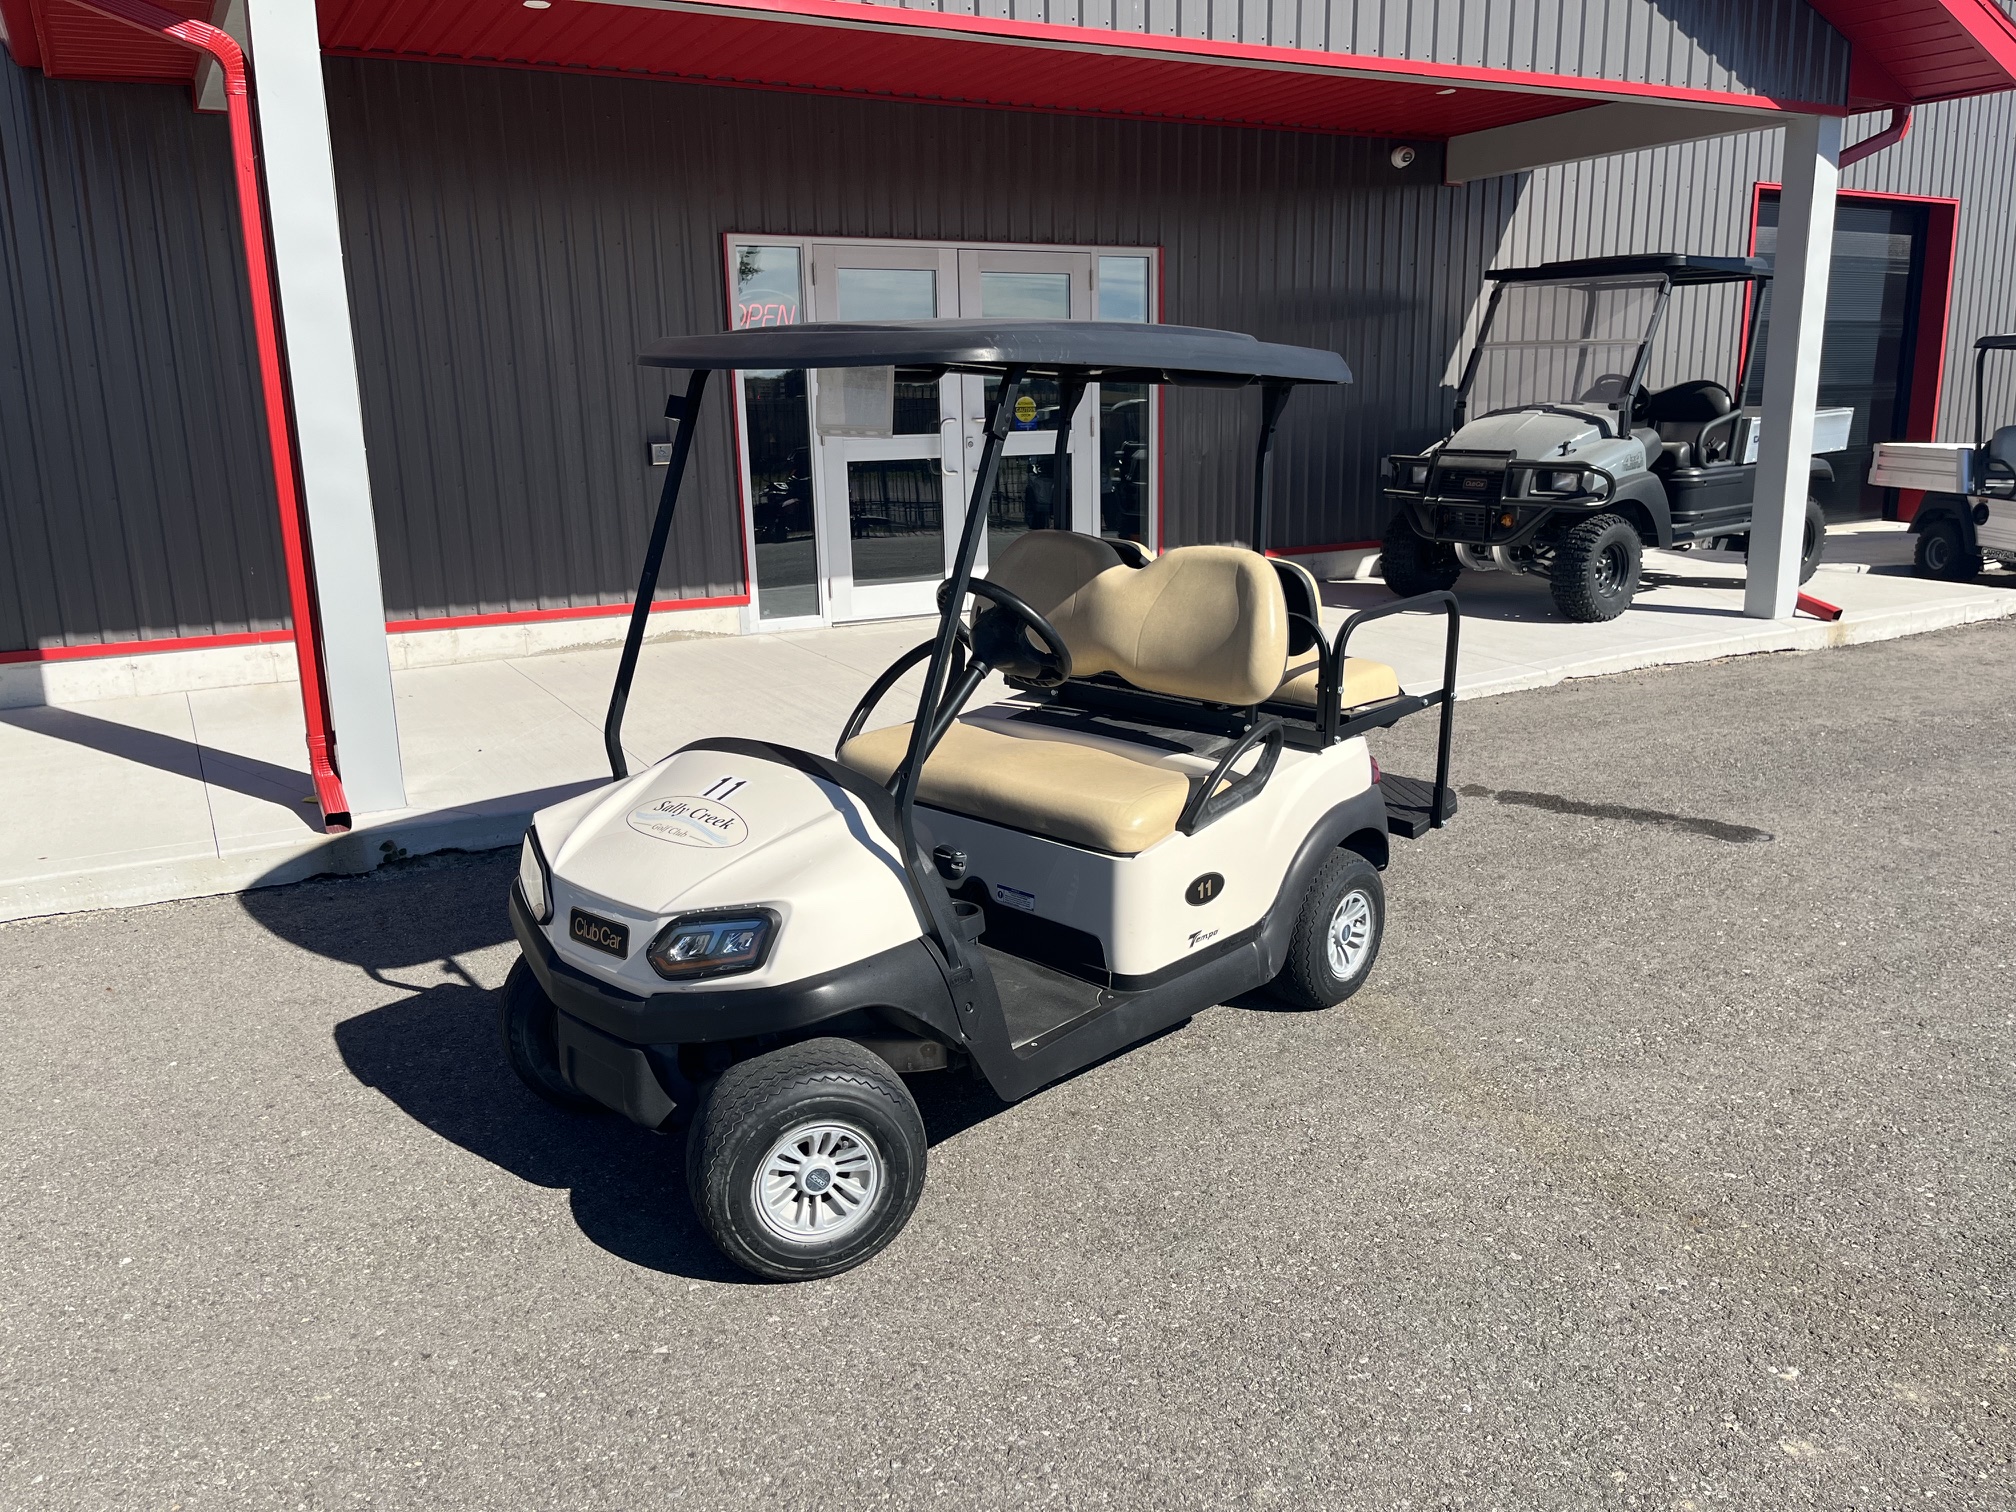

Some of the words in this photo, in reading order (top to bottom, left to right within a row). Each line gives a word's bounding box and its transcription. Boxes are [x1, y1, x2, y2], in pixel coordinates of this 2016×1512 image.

[702, 776, 747, 801] 11
[653, 800, 690, 817] Sally
[689, 808, 735, 830] Creek
[651, 823, 669, 834] Golf
[668, 827, 688, 838] Club
[1197, 879, 1212, 899] 11
[1187, 929, 1220, 949] Tempo
